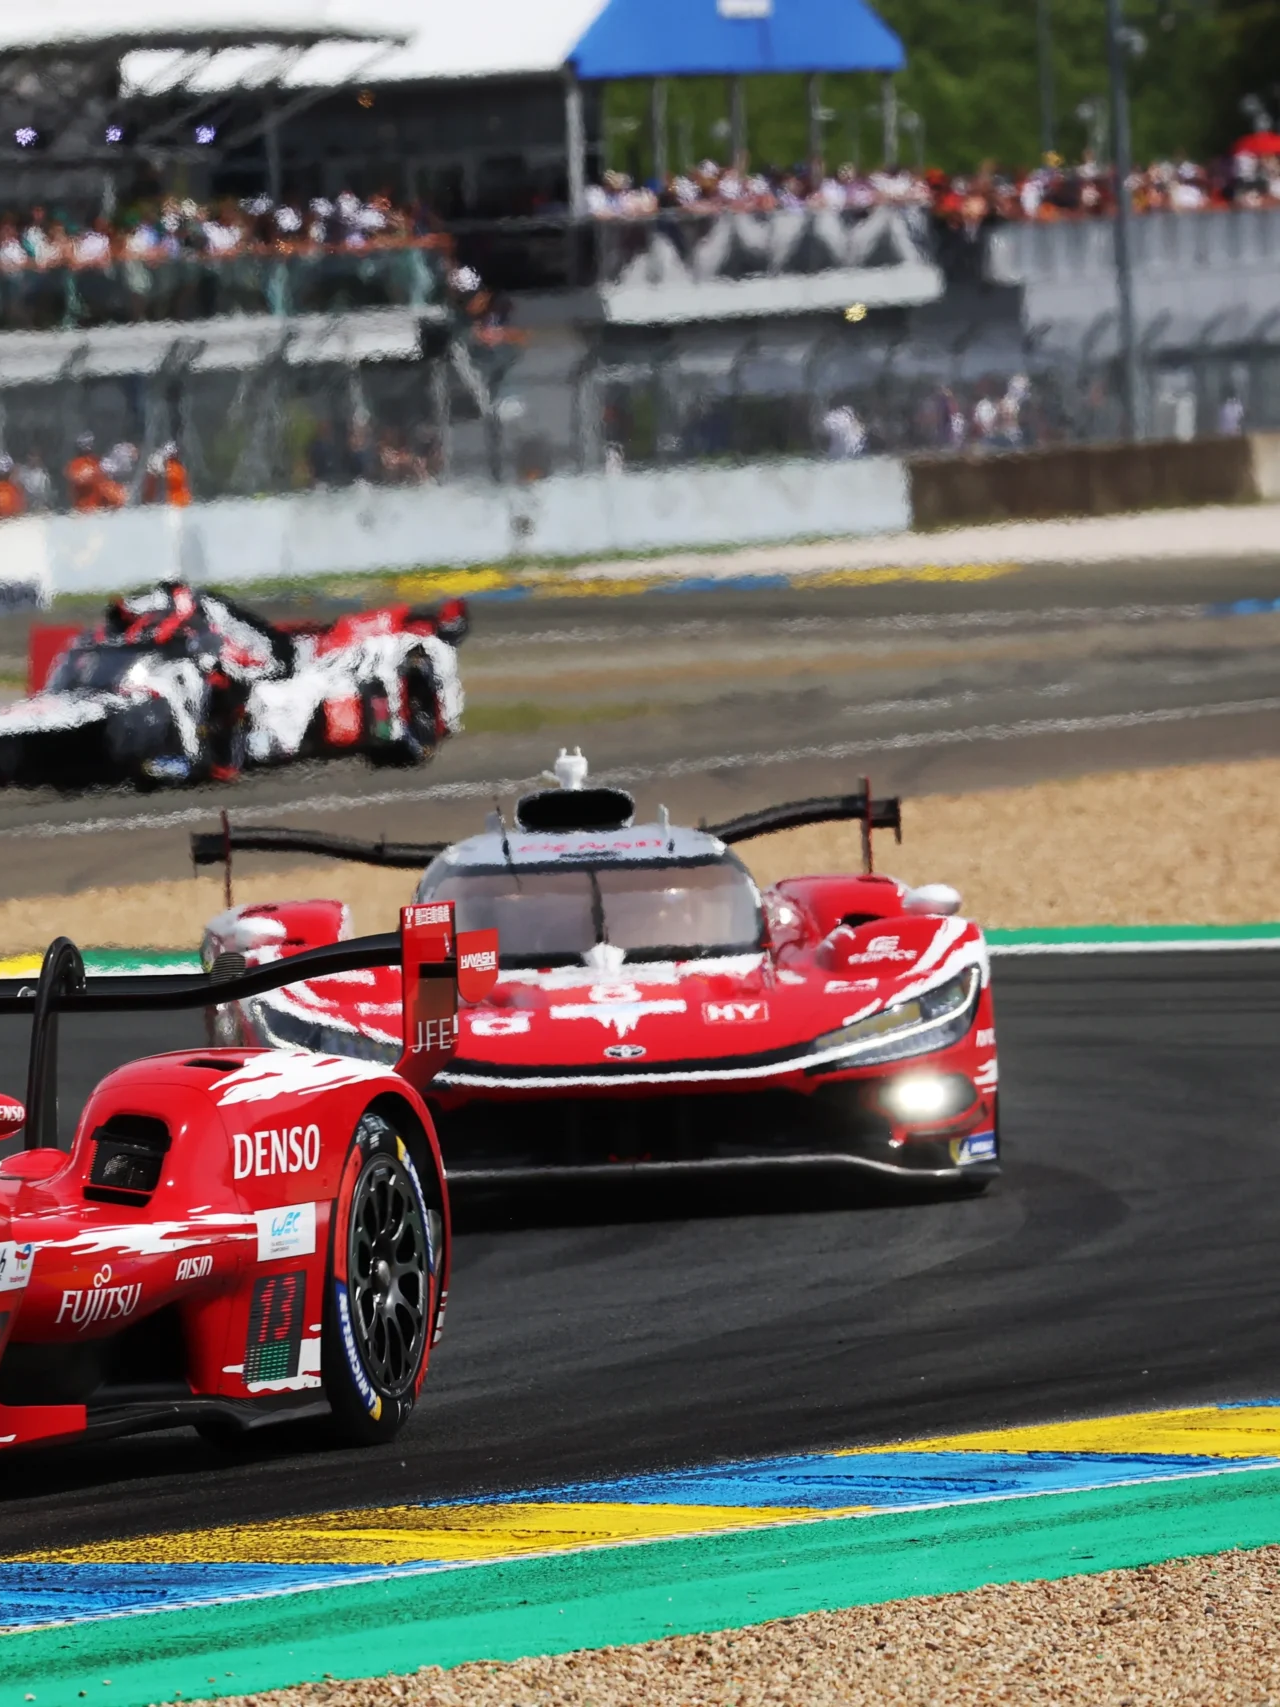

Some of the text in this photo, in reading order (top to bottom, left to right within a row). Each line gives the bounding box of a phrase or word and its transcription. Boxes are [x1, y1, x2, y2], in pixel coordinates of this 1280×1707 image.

[460, 951, 496, 969] HAYASHI
[707, 1003, 761, 1021] HY
[412, 1018, 452, 1054] JFE
[232, 1123, 321, 1179] DENSO
[271, 1211, 301, 1236] WEC
[175, 1255, 214, 1281] AISIN
[55, 1282, 142, 1332] FUJITSU
[339, 1292, 371, 1397] MICHELIN
